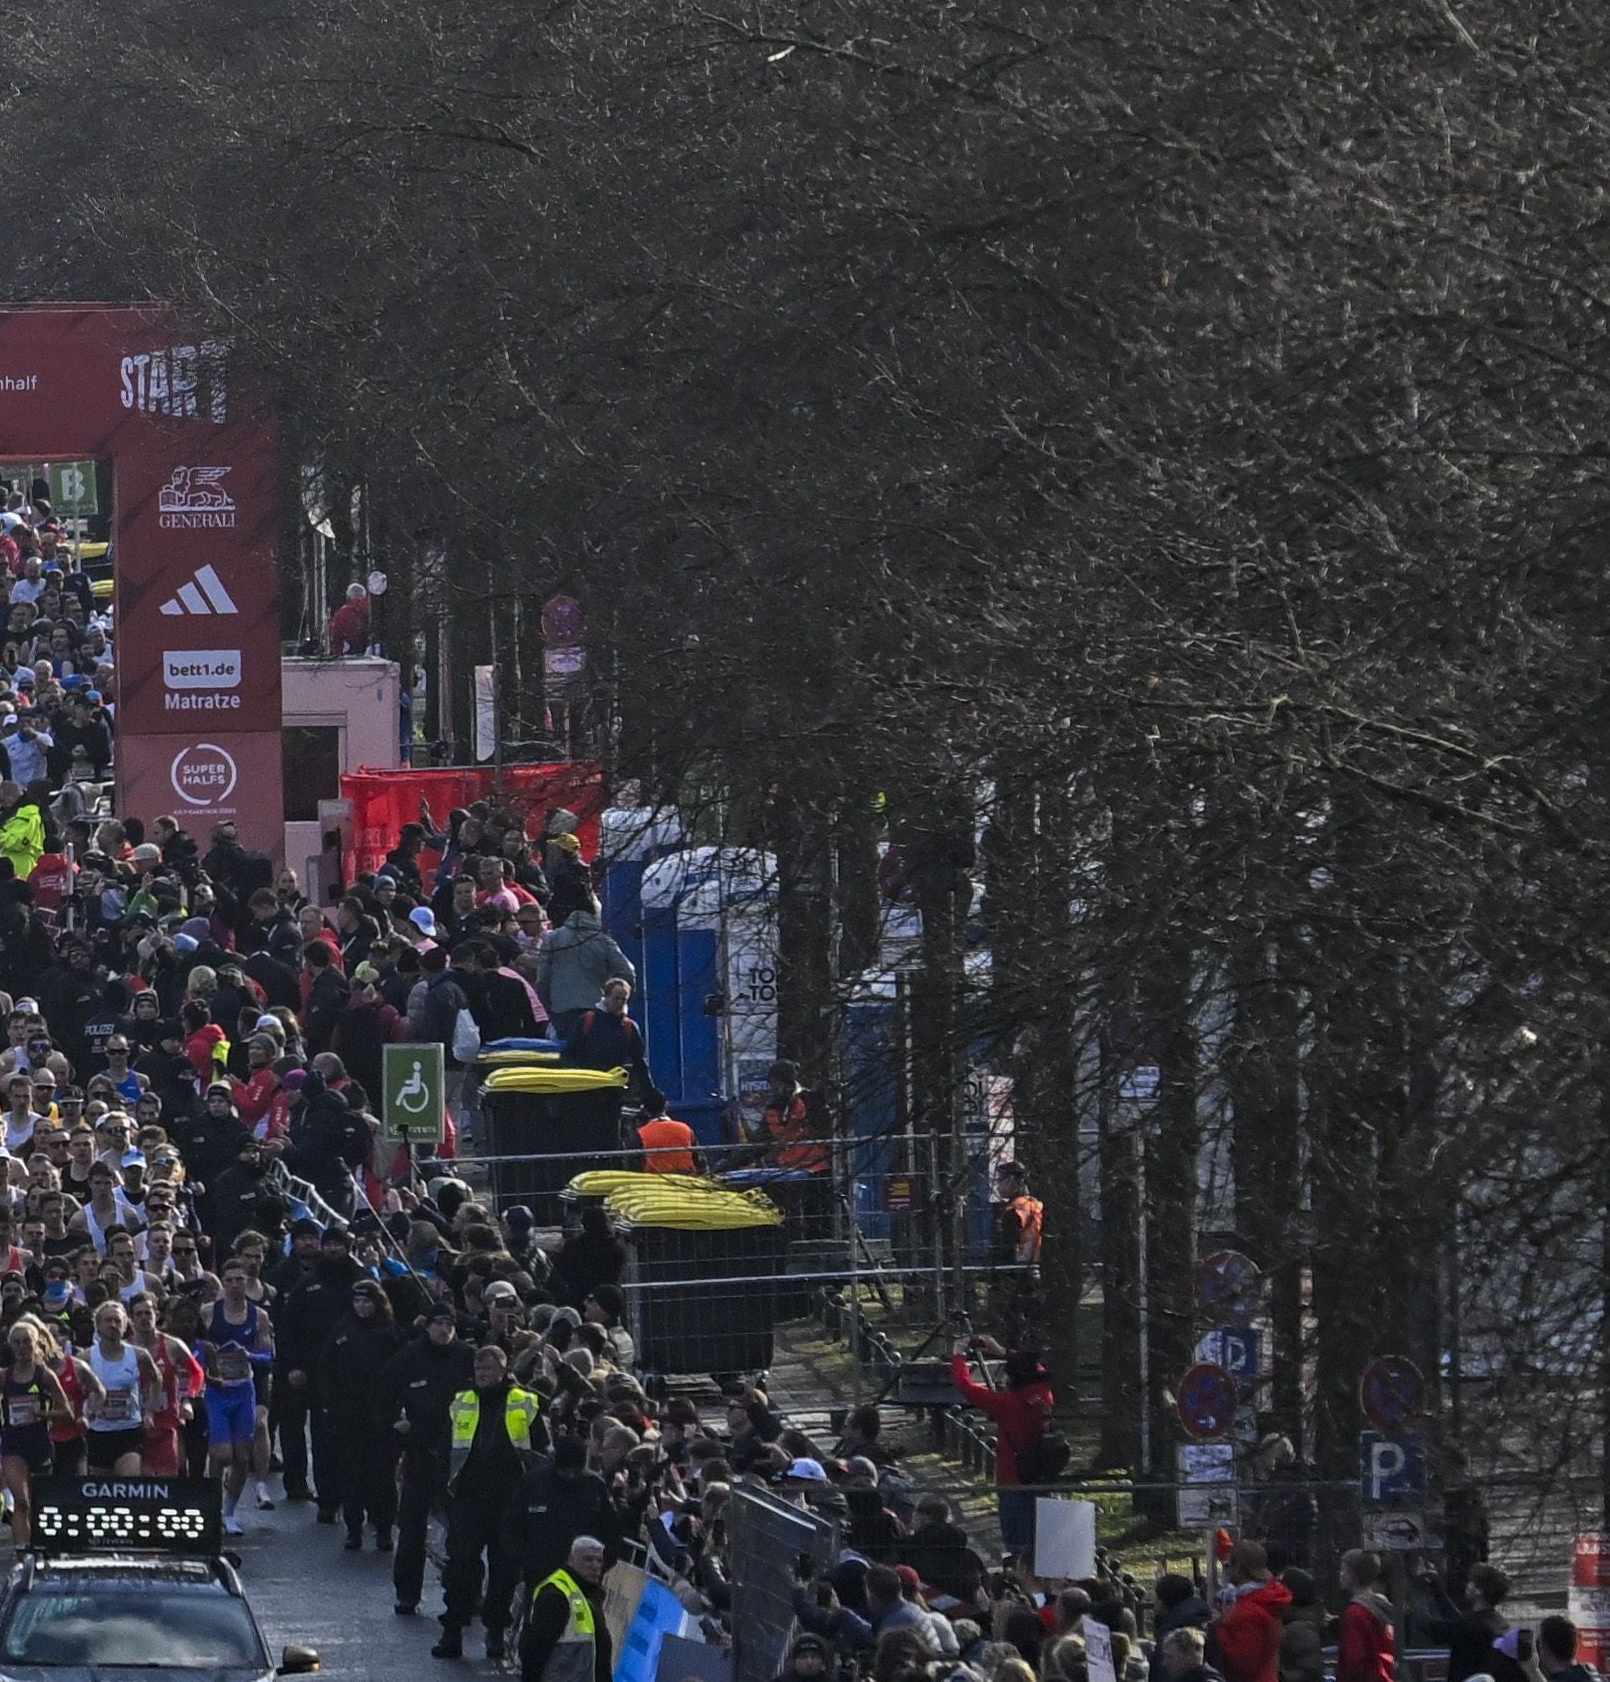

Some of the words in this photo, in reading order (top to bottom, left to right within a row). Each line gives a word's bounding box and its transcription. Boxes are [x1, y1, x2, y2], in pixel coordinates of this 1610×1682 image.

[60, 469, 85, 501] B
[160, 513, 235, 529] GENERALI
[169, 663, 235, 677] bett1.de
[165, 693, 241, 710] Matratze
[183, 764, 225, 775] SUPER
[183, 775, 225, 785] HALFS
[750, 969, 779, 985] TO
[749, 985, 779, 1001] TO
[85, 1024, 115, 1036] POLIZEI
[1372, 1442, 1406, 1499] P
[82, 1483, 169, 1499] GARMIN
[39, 1507, 204, 1538] 0:00:00
